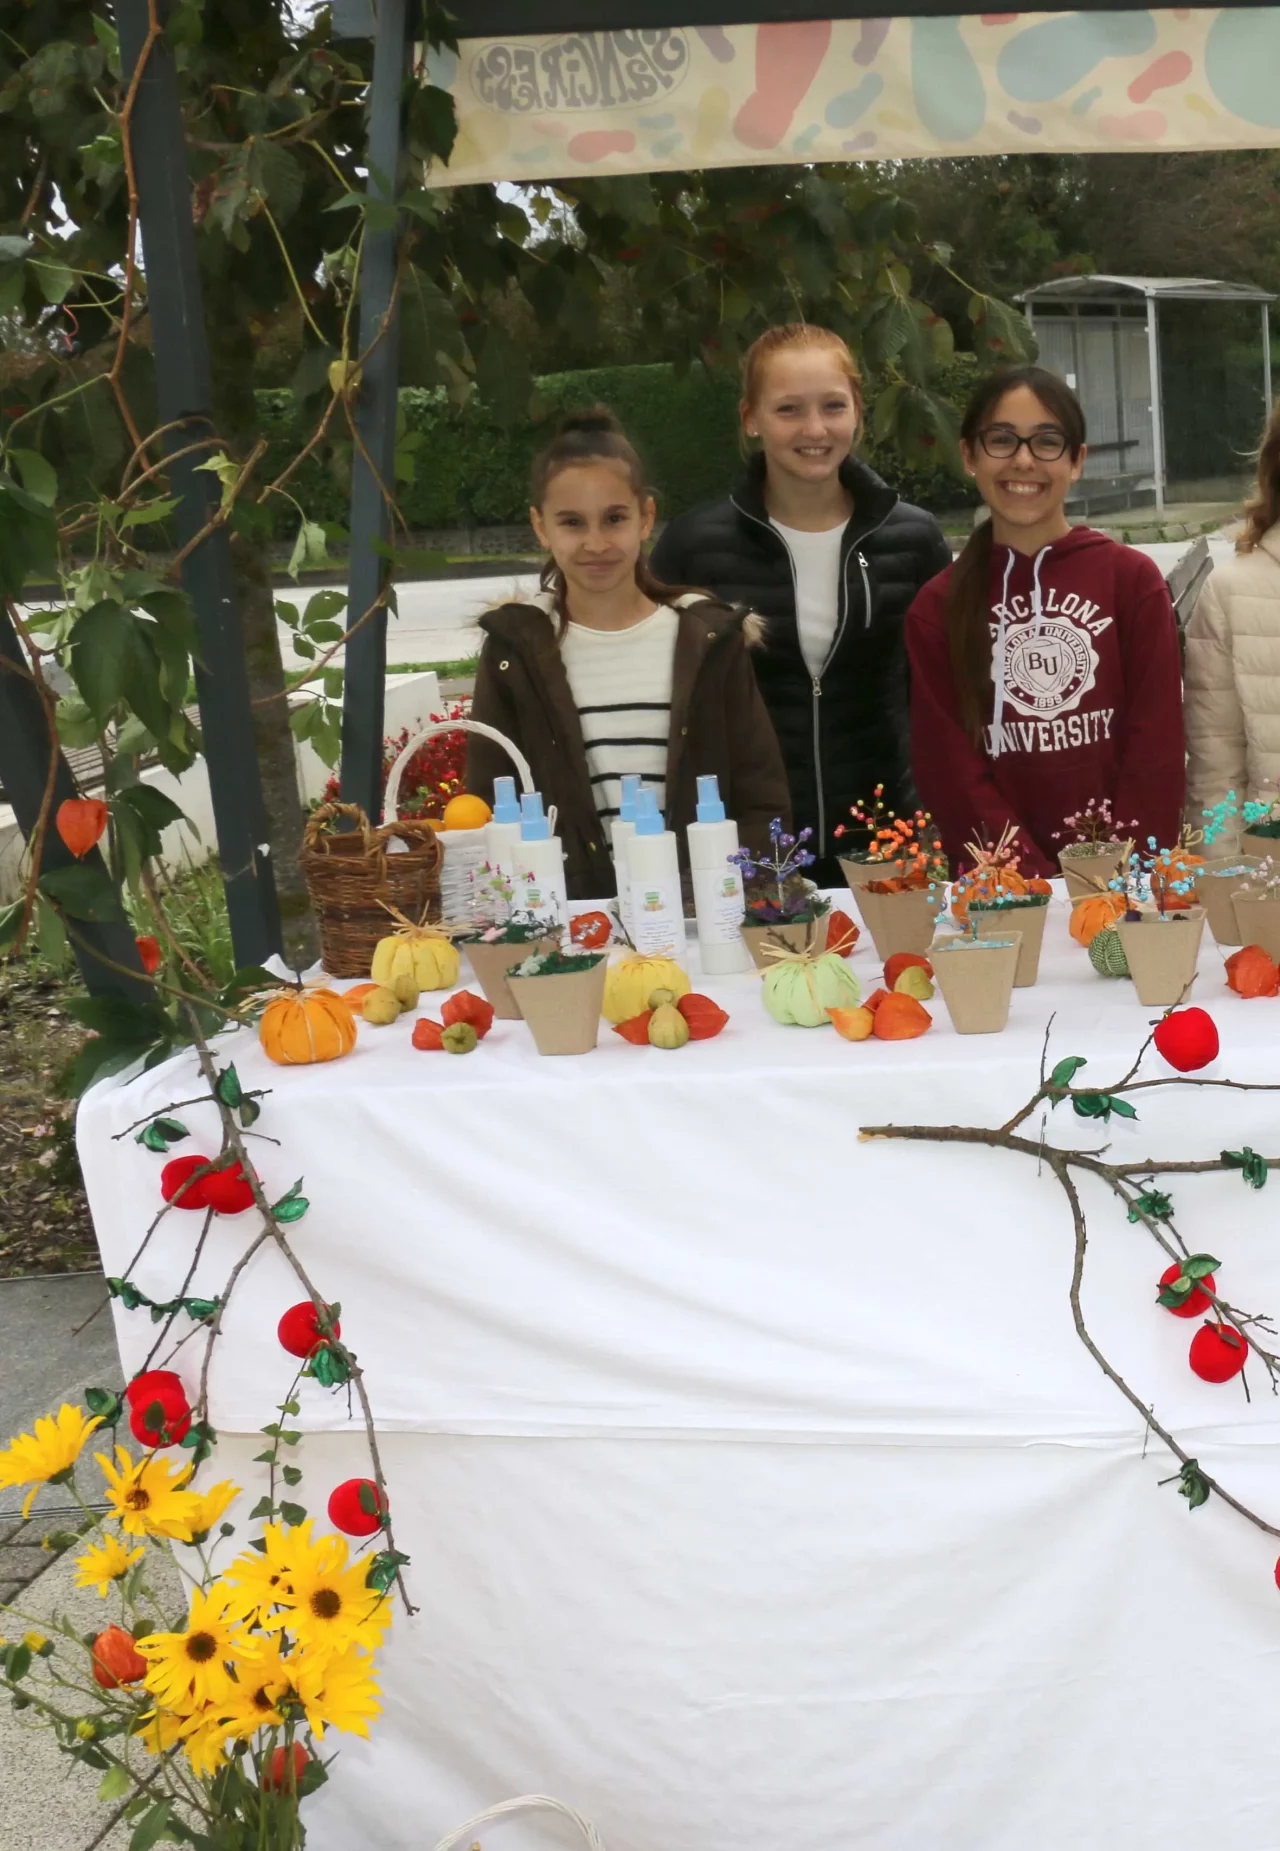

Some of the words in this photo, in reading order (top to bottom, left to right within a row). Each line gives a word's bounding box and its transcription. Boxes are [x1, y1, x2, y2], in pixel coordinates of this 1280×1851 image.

[988, 588, 1113, 636] ARCLONA
[1028, 652, 1057, 676] BU
[1045, 626, 1088, 681] UNIVERSITY
